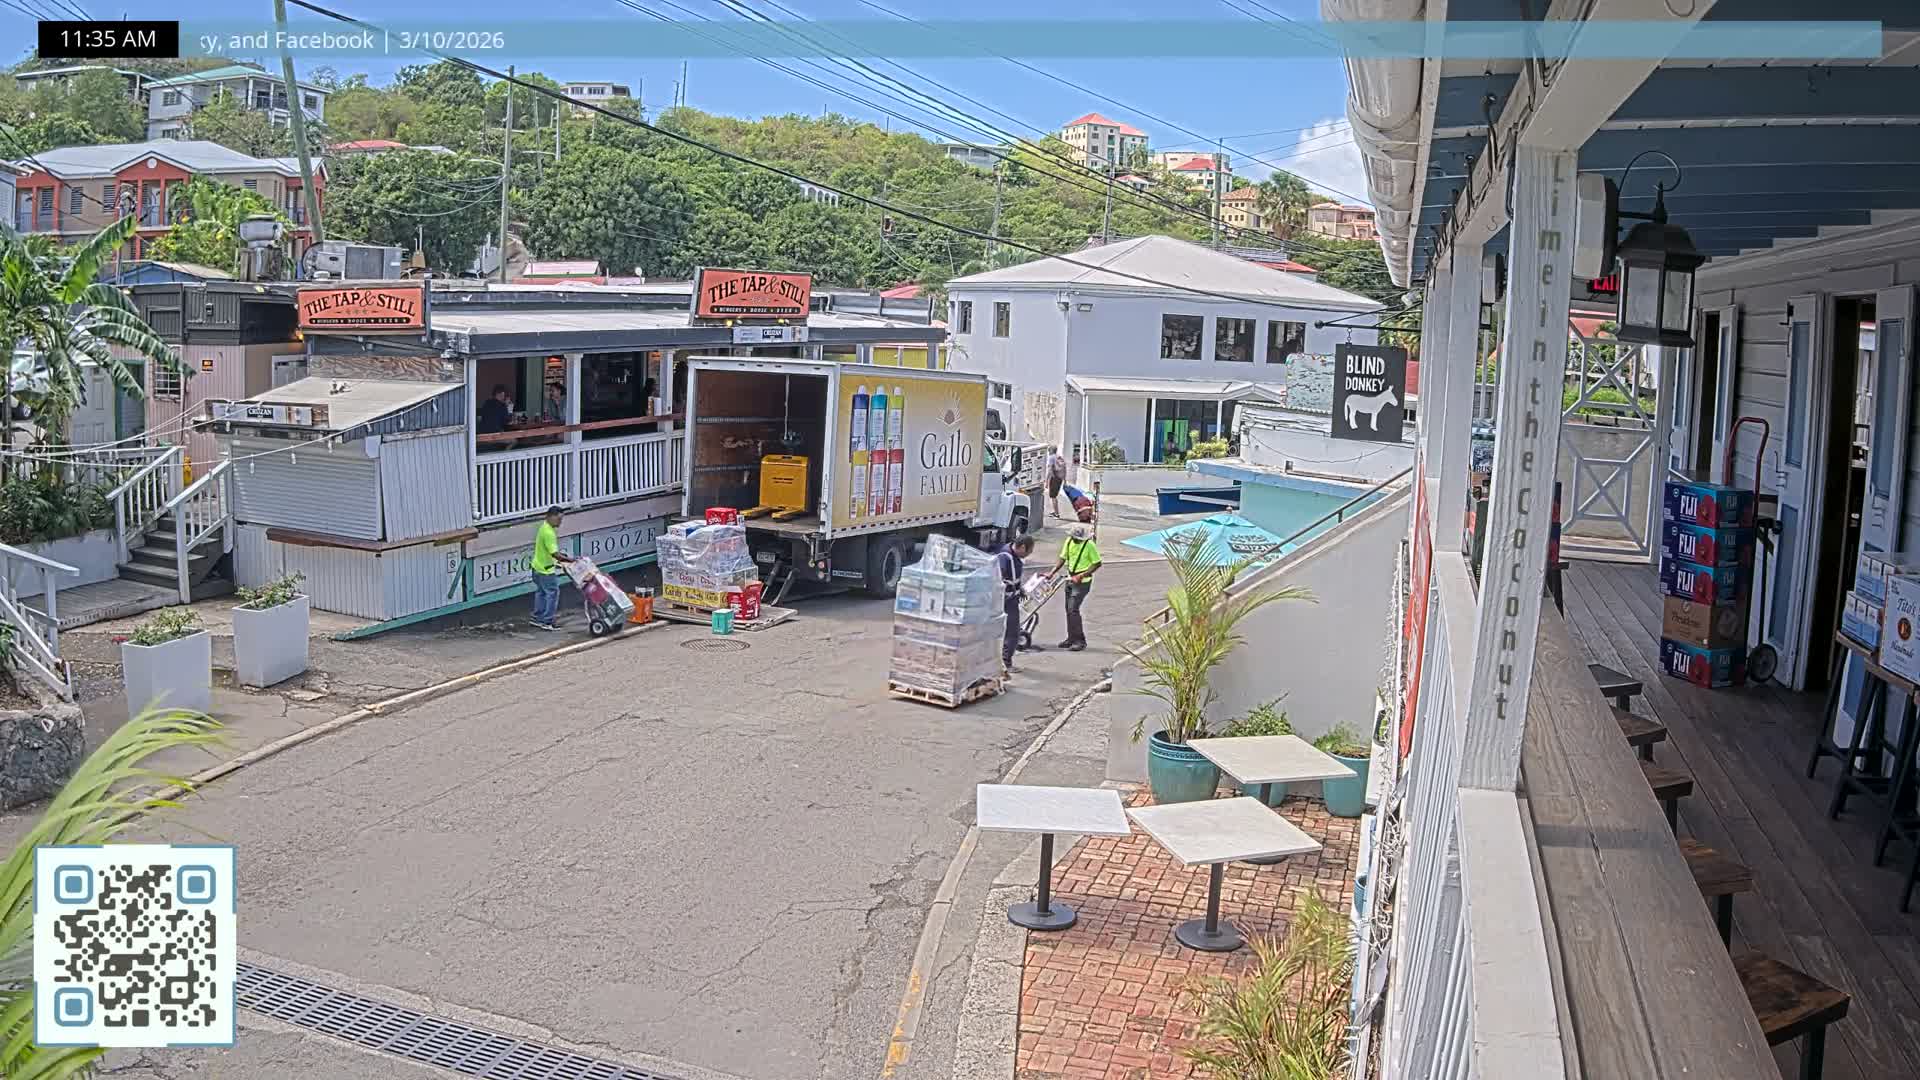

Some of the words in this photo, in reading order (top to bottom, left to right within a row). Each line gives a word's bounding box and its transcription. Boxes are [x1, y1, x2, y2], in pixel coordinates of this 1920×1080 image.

[708, 280, 738, 303] THE
[740, 275, 767, 293] TAP
[779, 279, 805, 307] STILL
[304, 296, 331, 317] THE
[331, 292, 360, 307] TAP
[376, 293, 416, 317] STILL
[1346, 354, 1385, 376] BLIND
[1345, 377, 1385, 392] DONKEY
[920, 429, 972, 470] Gallo
[920, 472, 969, 496] FAMILY
[1680, 495, 1698, 517] FIJI
[591, 527, 656, 556] BOOZE
[1679, 533, 1696, 556] FIJI
[1677, 570, 1694, 593] FIJI
[1673, 650, 1690, 674] FIJI
